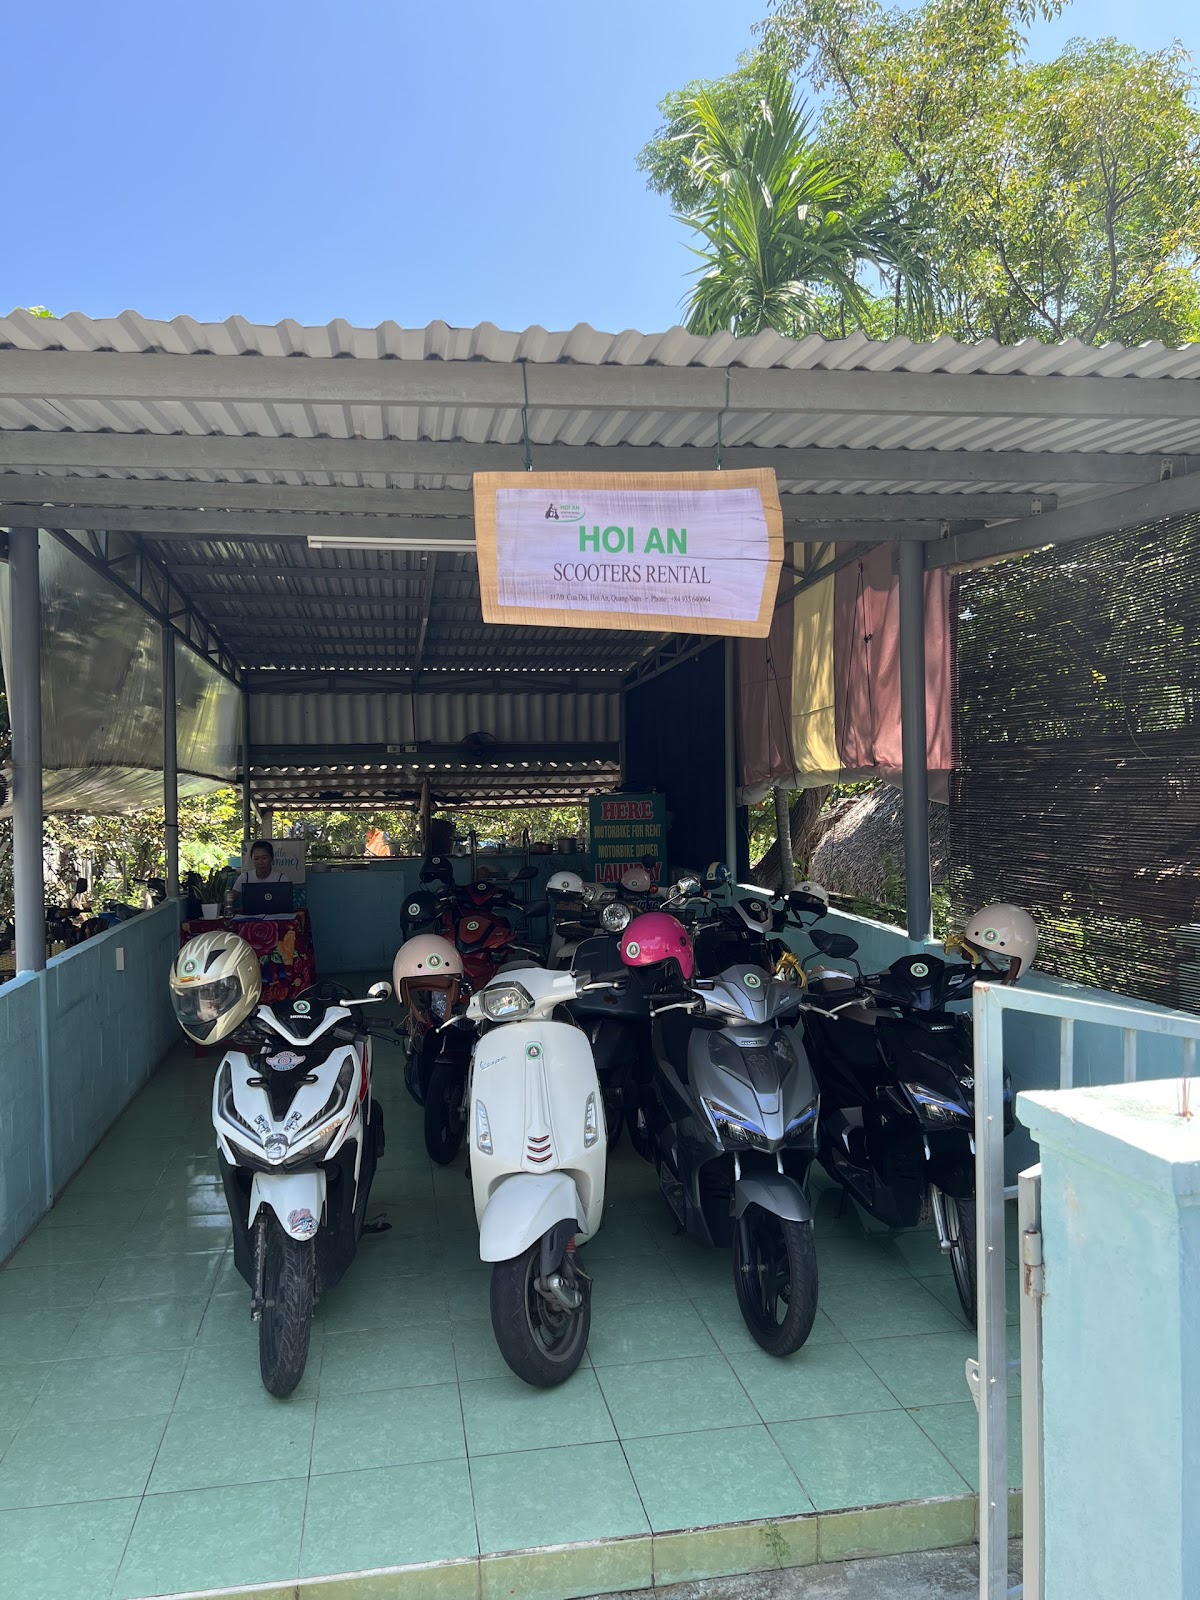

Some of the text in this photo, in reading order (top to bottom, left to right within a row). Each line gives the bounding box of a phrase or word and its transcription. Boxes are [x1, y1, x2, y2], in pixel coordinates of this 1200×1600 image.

[579, 526, 688, 554] HOI AN
[553, 562, 712, 584] SCOOTERS RENTAL
[610, 594, 628, 604] Quang
[601, 801, 654, 820] HERE
[594, 824, 662, 838] MOTORBIKE FOR RENT
[598, 844, 658, 858] MOTORBIKE DRIVER
[595, 862, 662, 884] LAUY
